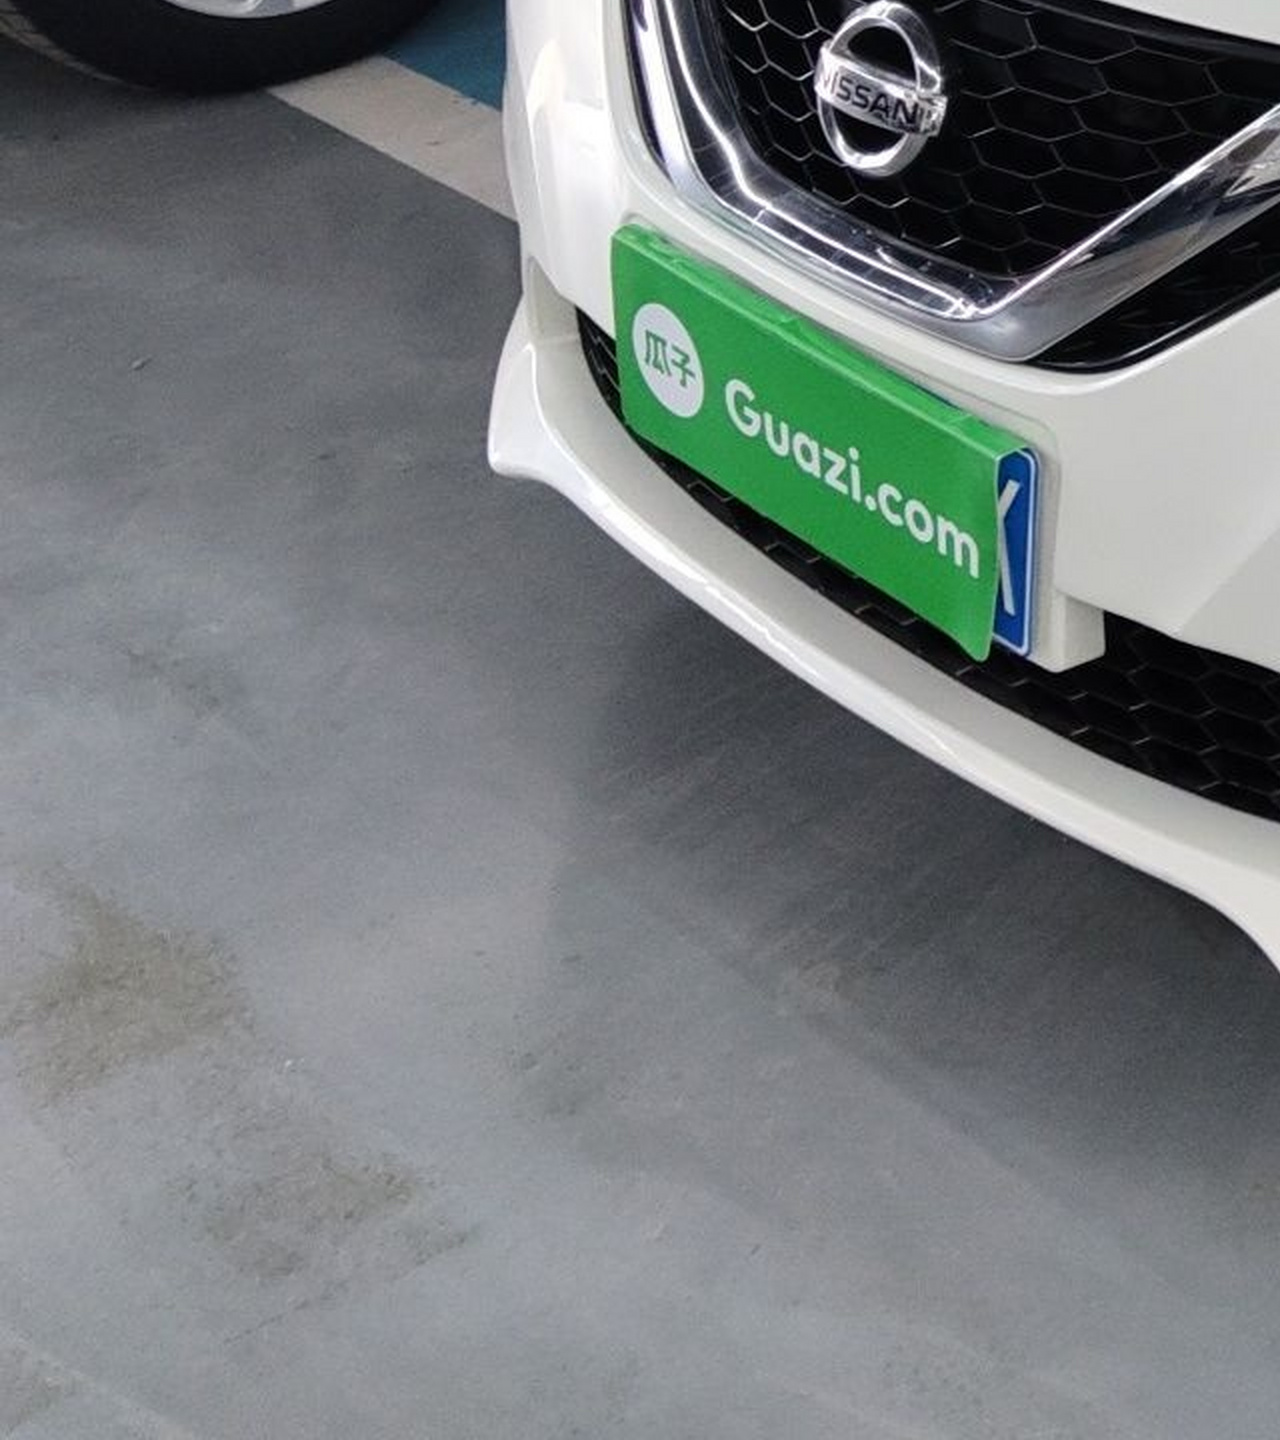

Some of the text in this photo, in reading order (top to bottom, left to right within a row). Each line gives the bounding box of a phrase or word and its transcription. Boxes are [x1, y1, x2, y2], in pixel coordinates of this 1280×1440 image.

[821, 67, 920, 126] NISSAN
[644, 329, 696, 388] 瓜子
[725, 379, 980, 579] Guazi.com
